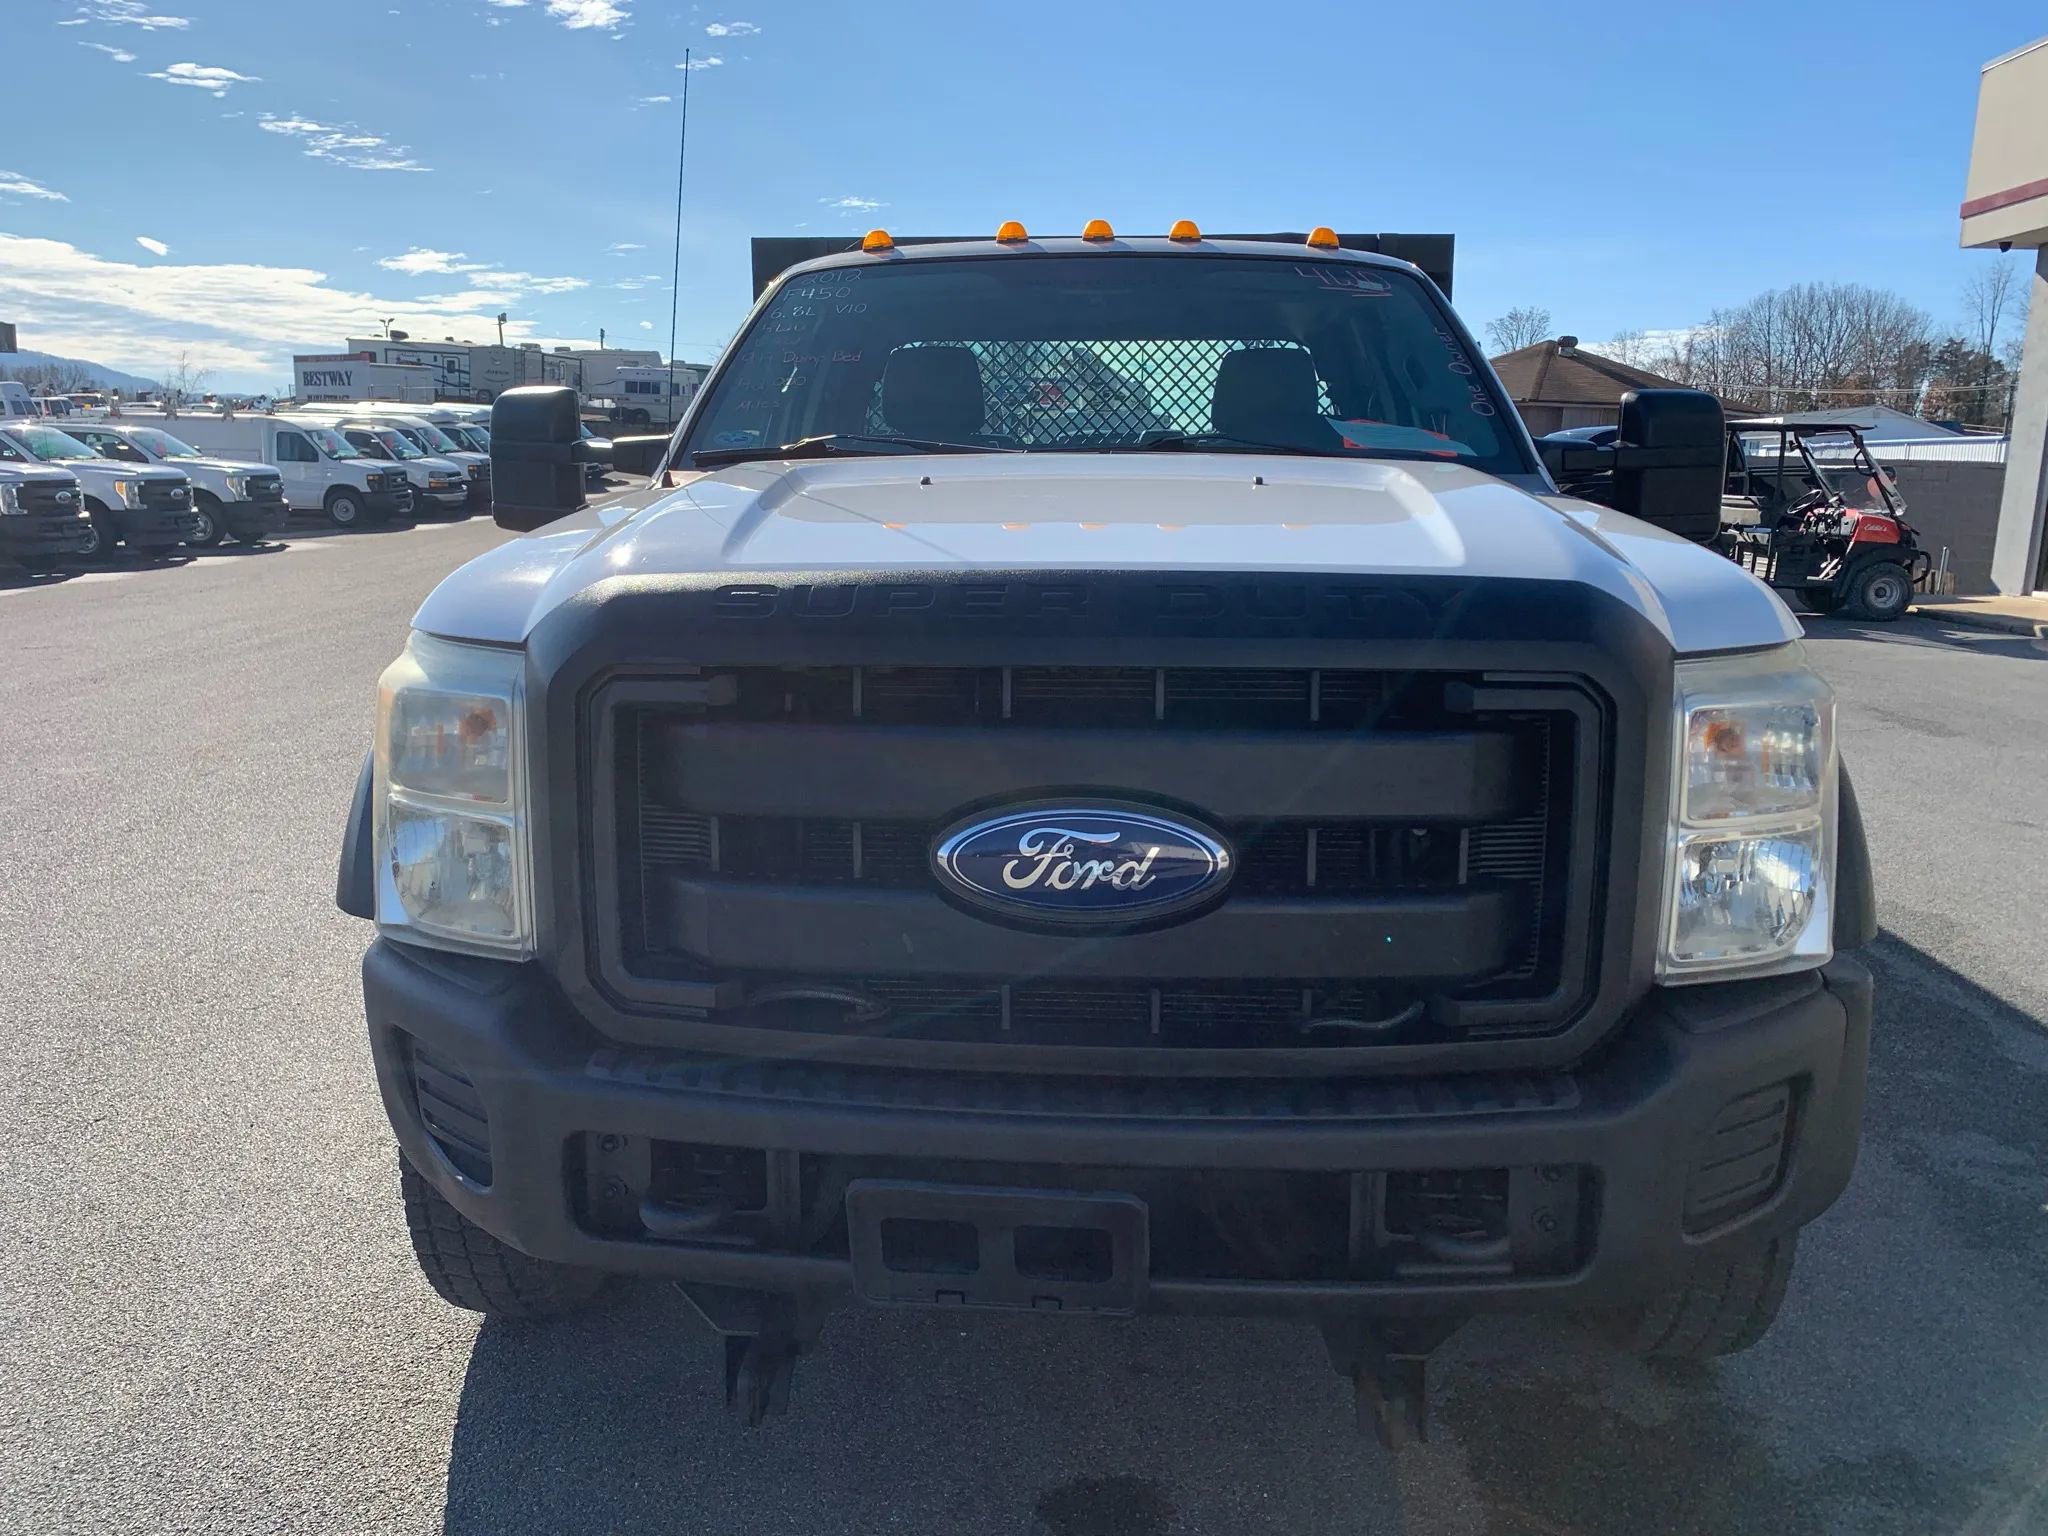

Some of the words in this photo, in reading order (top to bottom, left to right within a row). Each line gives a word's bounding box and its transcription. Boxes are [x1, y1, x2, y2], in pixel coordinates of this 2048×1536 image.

[801, 269, 862, 284] 2012
[1294, 266, 1393, 291] 4WD
[783, 287, 851, 301] F450
[835, 303, 868, 314] V10
[832, 351, 862, 362] Bed
[1434, 327, 1473, 375] Owner
[303, 370, 353, 386] BESTWAY
[1469, 383, 1495, 416] One
[714, 583, 1090, 619] SUPER
[1156, 584, 1466, 621] DUTY
[1002, 827, 1157, 890] Ford
